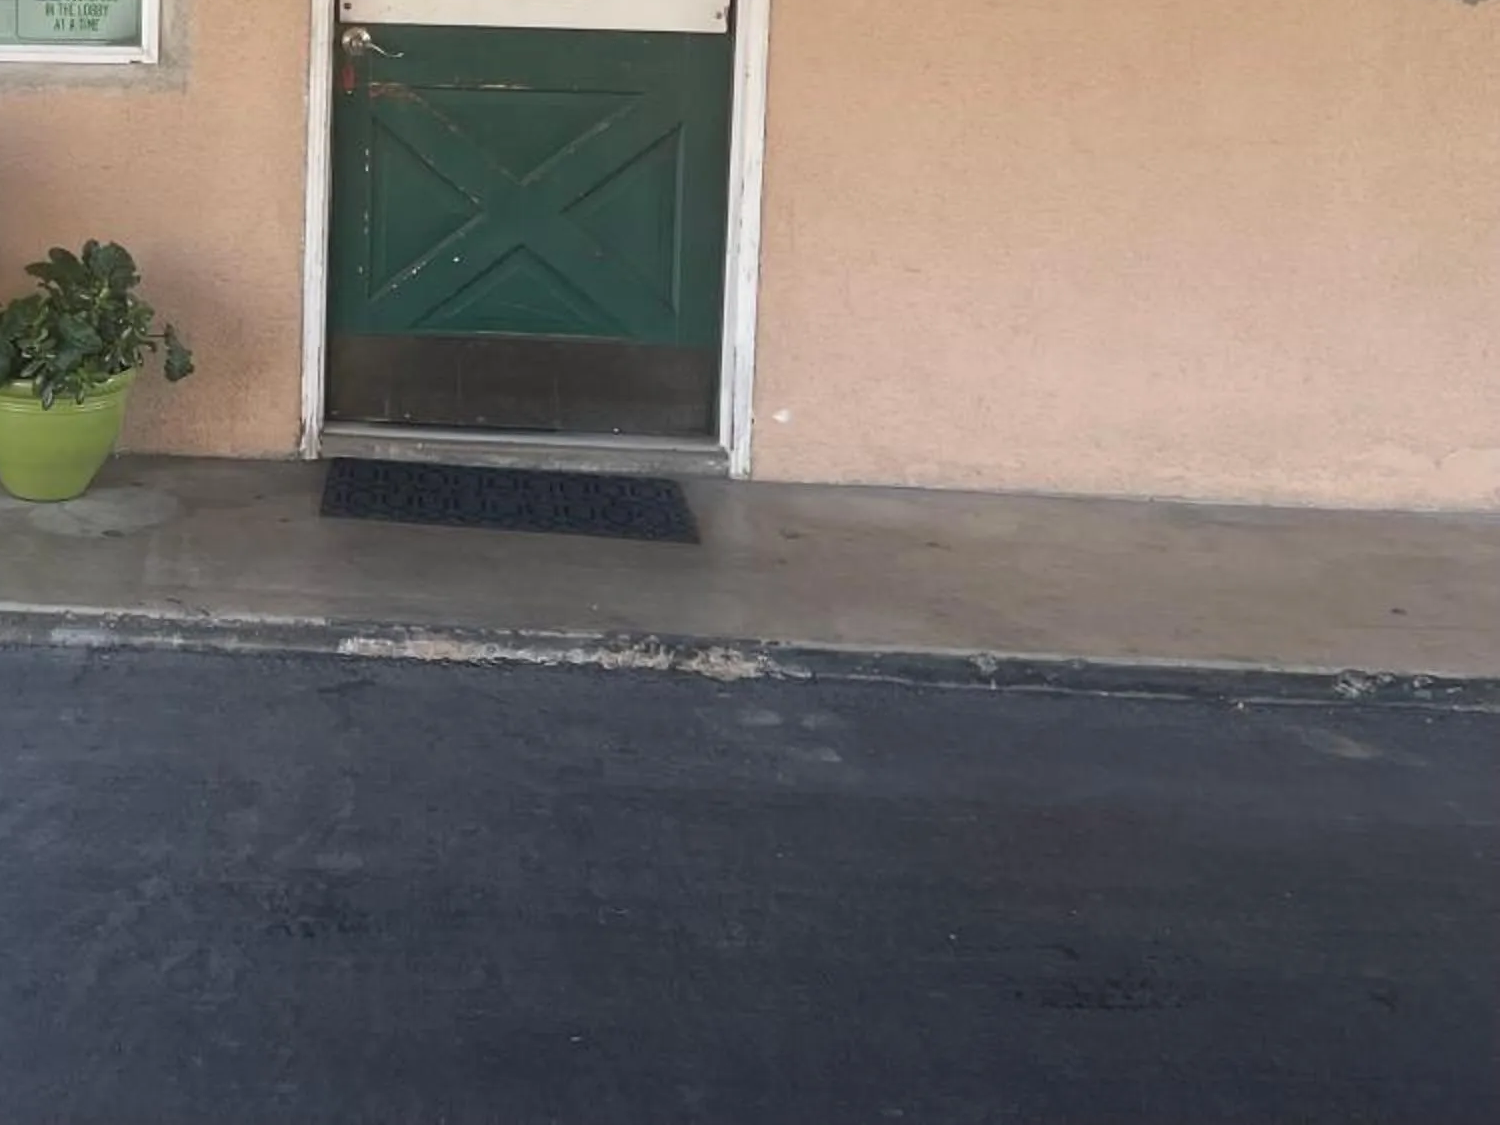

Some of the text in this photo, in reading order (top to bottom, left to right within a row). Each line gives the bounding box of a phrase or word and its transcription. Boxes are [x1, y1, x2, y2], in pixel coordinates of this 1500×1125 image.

[58, 2, 75, 16] THE
[77, 3, 109, 17] LOBBY
[79, 18, 100, 31] TIME
